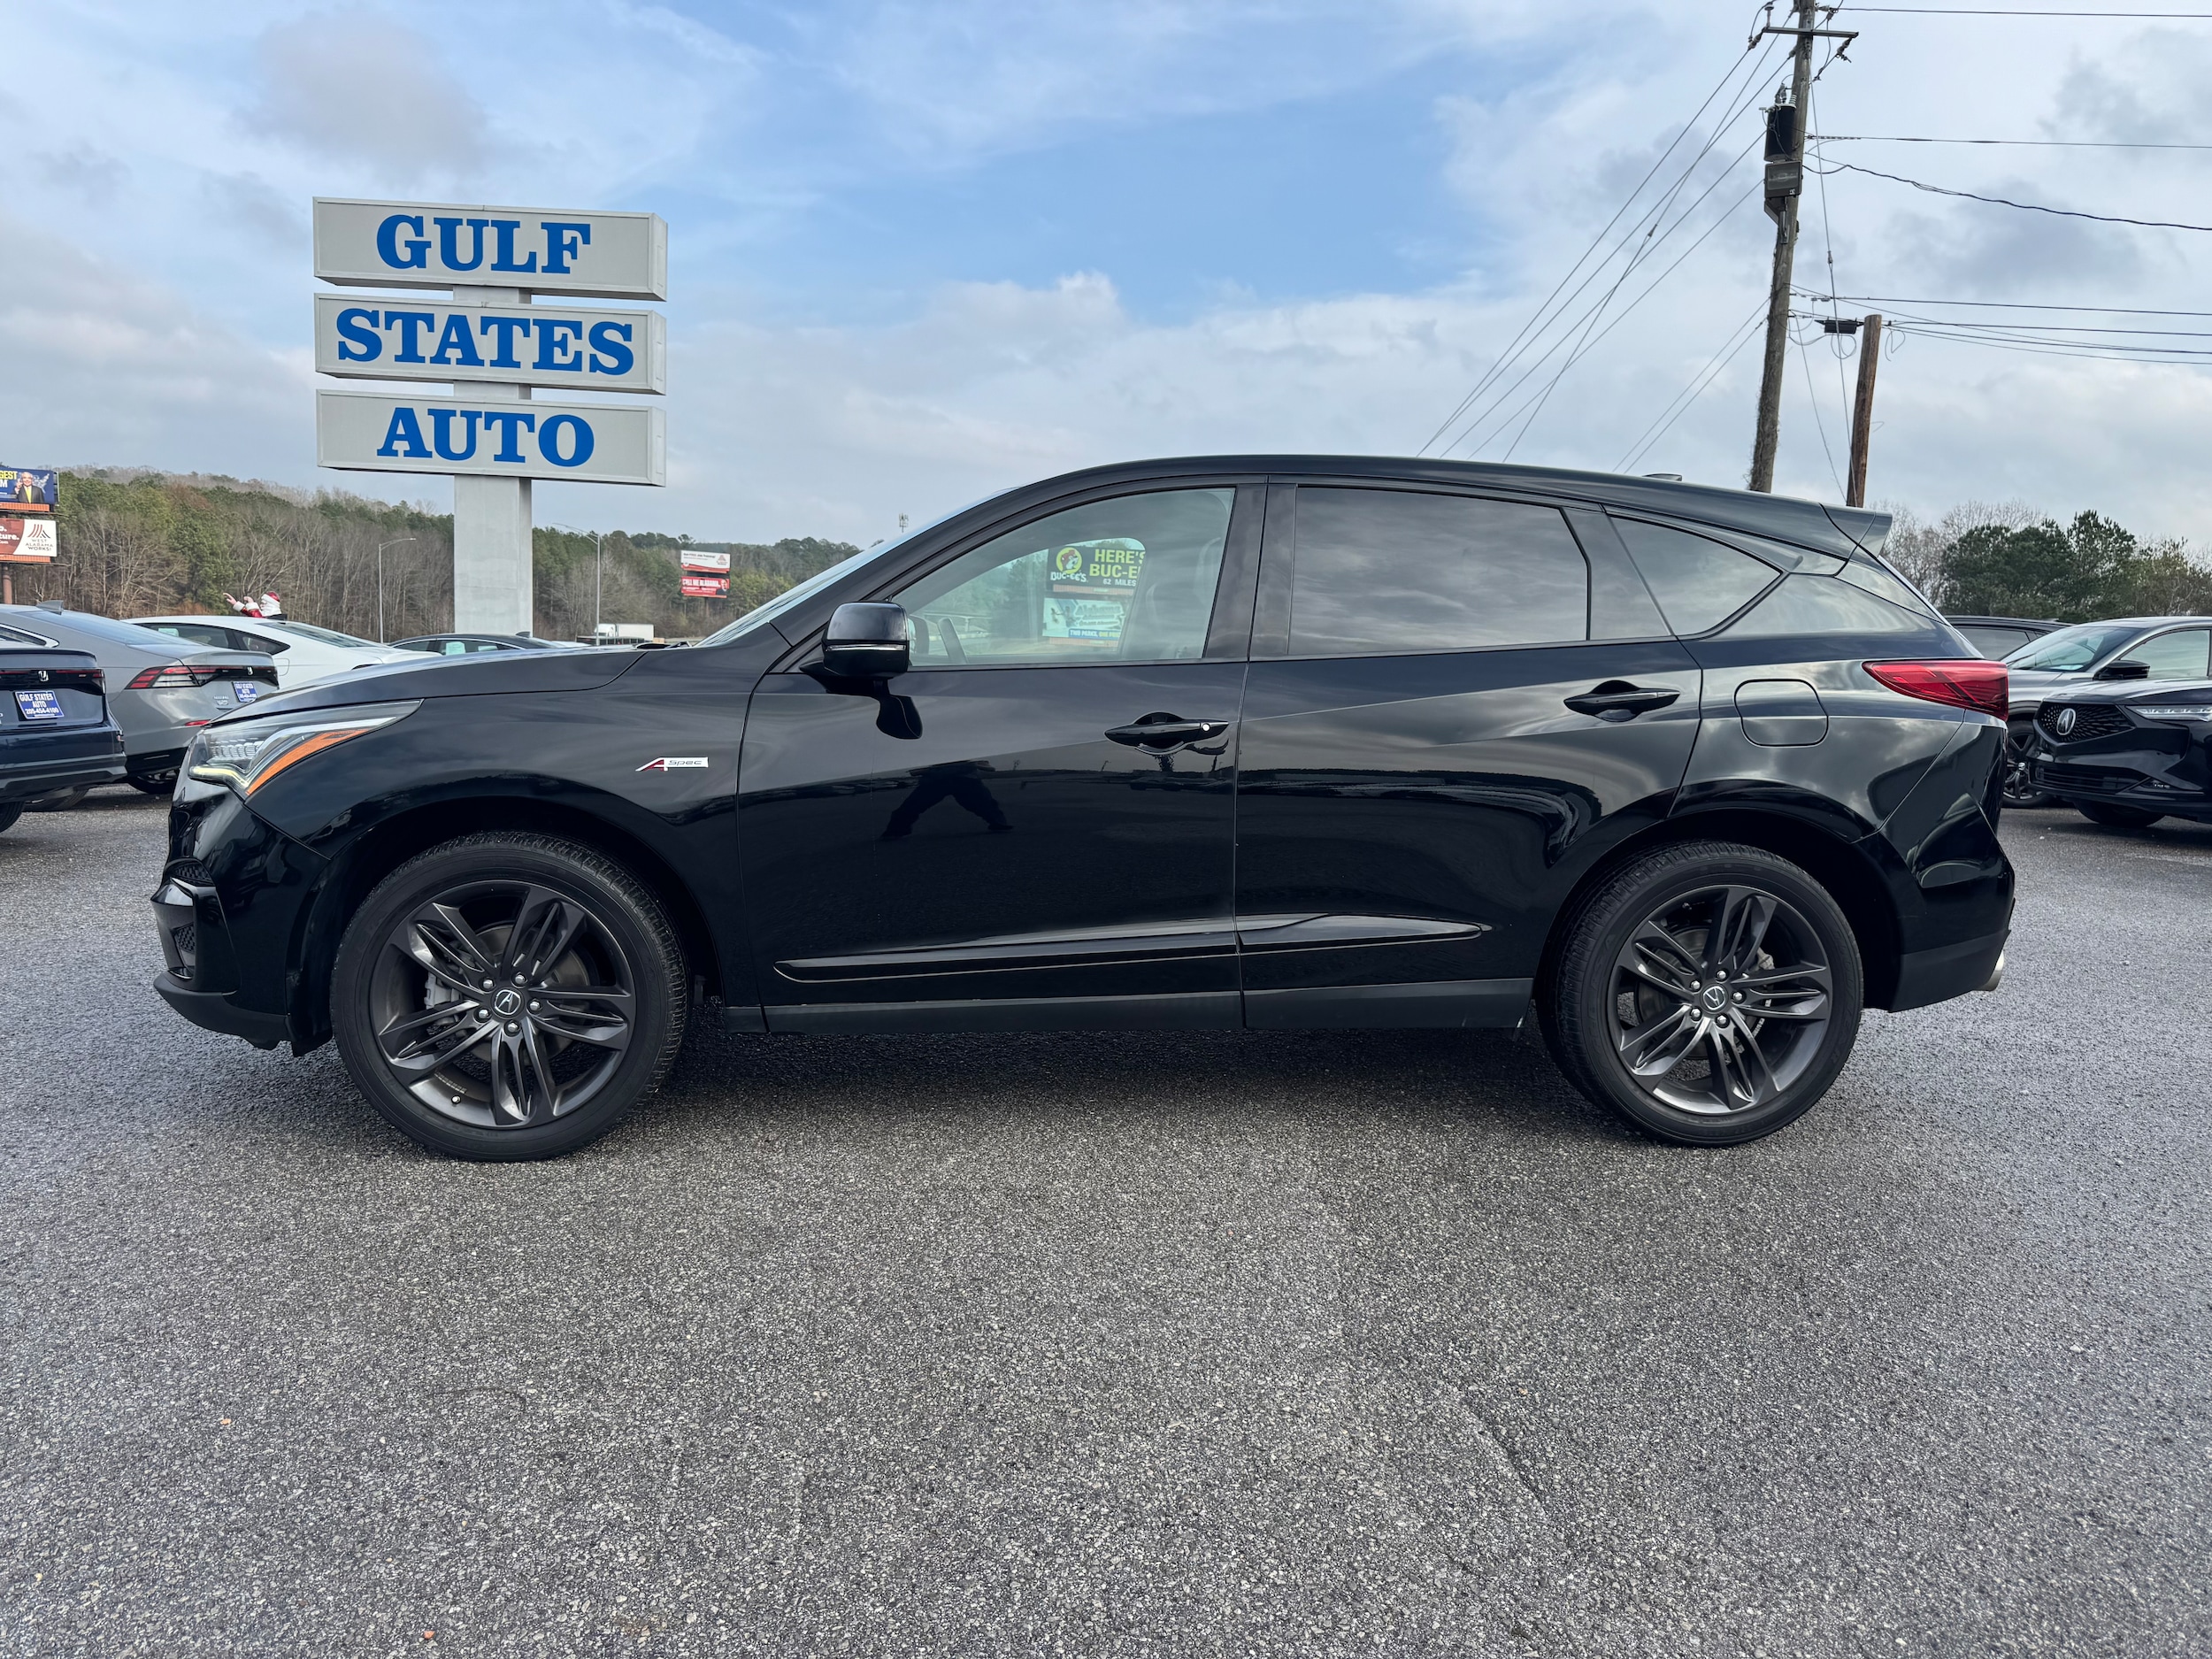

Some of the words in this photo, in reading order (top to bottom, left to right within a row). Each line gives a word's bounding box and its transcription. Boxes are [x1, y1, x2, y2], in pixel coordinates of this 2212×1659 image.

[376, 214, 591, 274] GULF
[336, 308, 634, 375] STATES
[376, 407, 595, 467] AUTO
